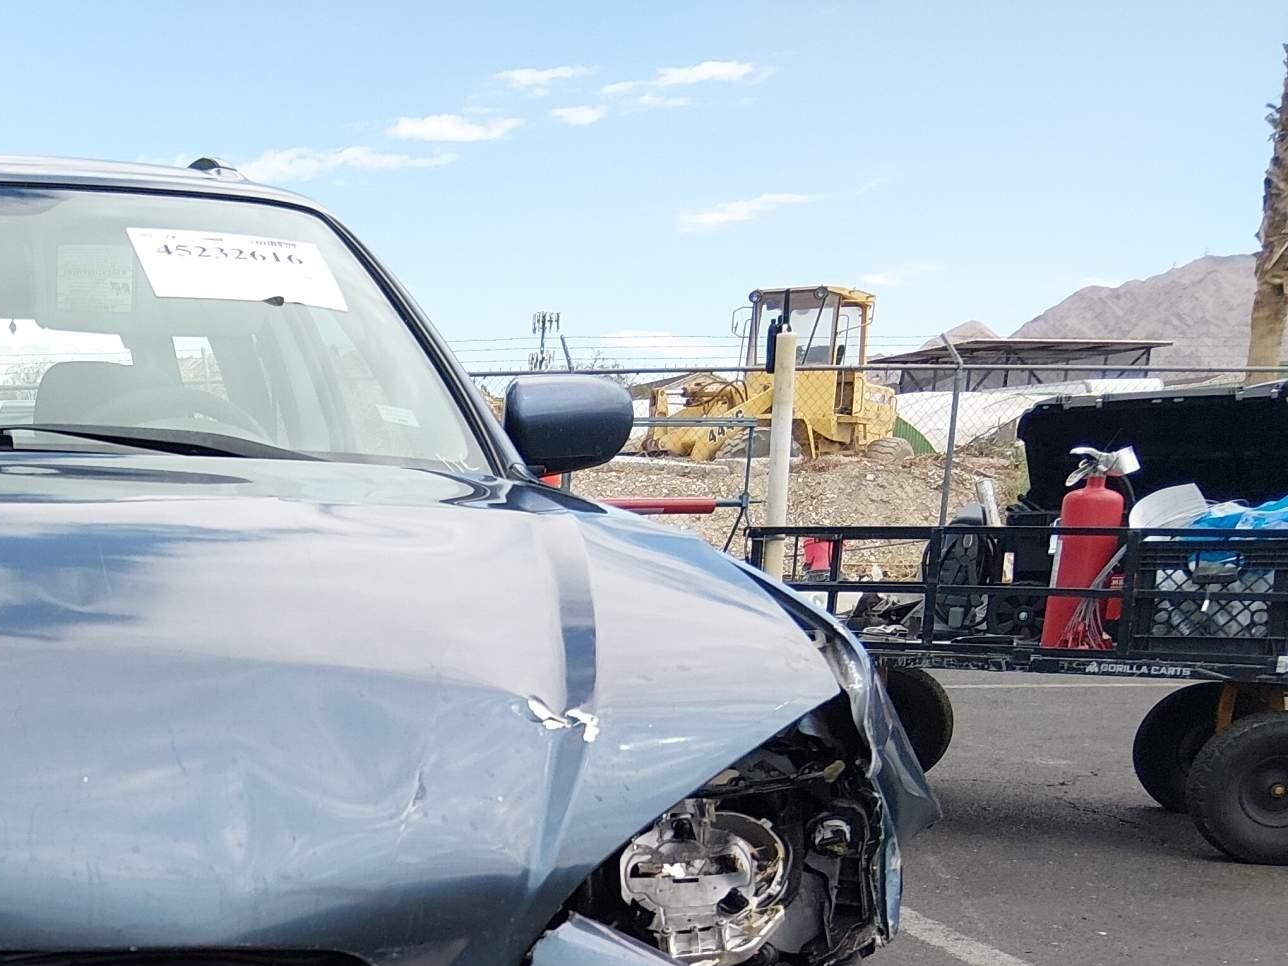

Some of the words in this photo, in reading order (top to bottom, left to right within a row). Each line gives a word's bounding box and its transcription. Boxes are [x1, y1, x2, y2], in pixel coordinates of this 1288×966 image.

[156, 243, 304, 265] 45232616
[1100, 663, 1148, 674] GORILLA
[1150, 666, 1192, 676] CARTS
